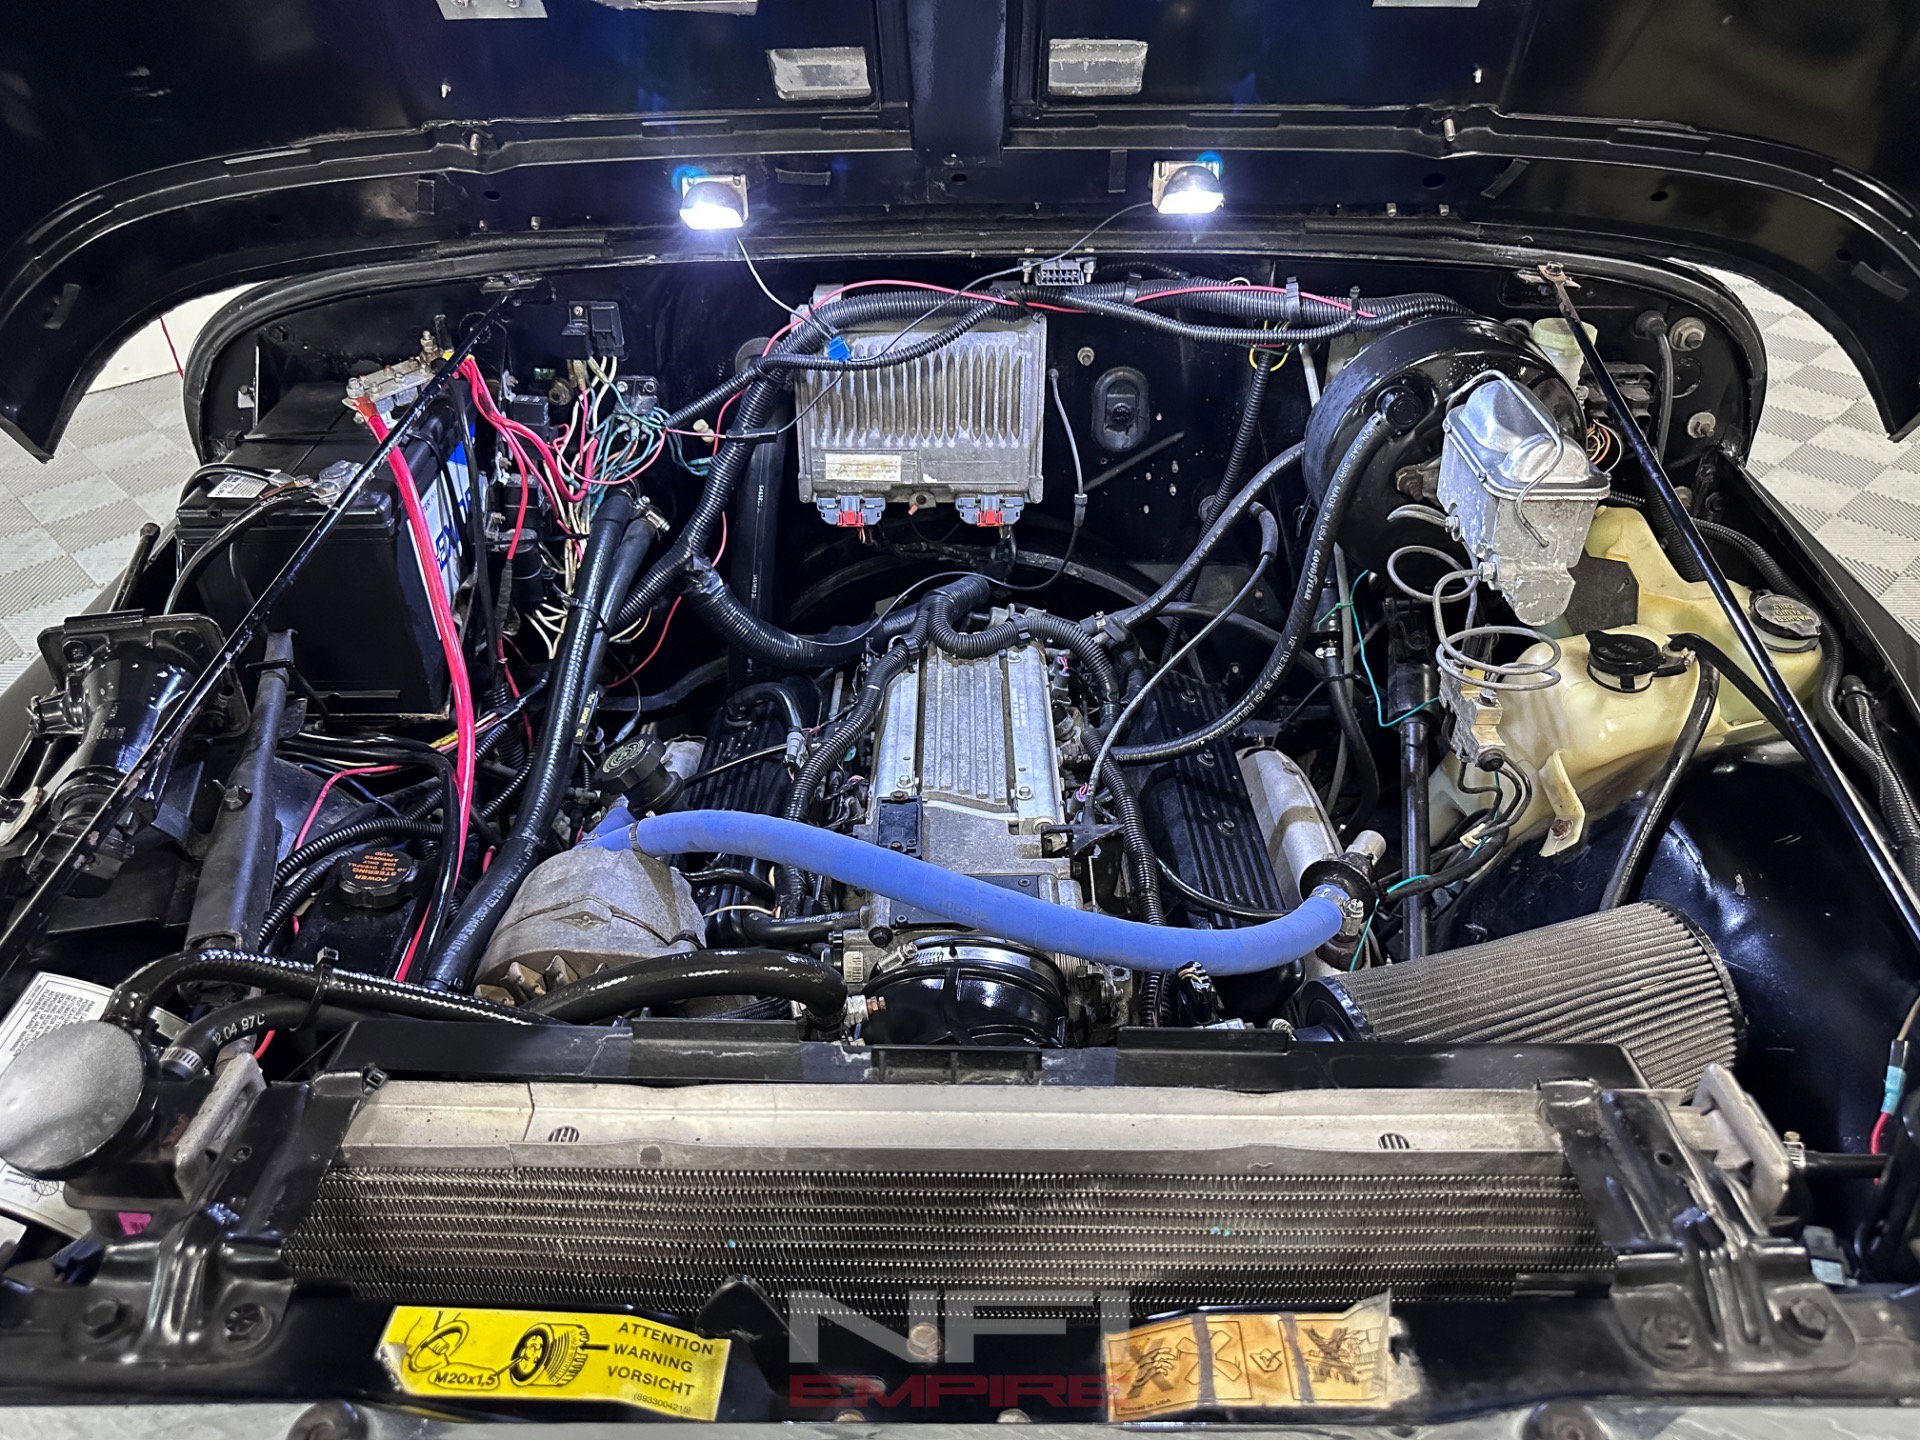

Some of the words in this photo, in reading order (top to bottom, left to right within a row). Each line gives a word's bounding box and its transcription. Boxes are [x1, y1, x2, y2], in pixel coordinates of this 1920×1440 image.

[1348, 440, 1363, 460] SAE
[1338, 462, 1352, 483] 30R7
[1326, 485, 1341, 510] MADE
[1323, 510, 1331, 522] IN
[1316, 524, 1328, 542] USA
[1304, 549, 1321, 602] GOODYEAR
[352, 868, 397, 876] STEERING
[224, 1022, 238, 1040] 04
[618, 1322, 714, 1355] ATTENTION
[614, 1342, 694, 1374] WARNING
[434, 1370, 498, 1387] M20x1,5
[608, 1366, 694, 1396] VORSICHT
